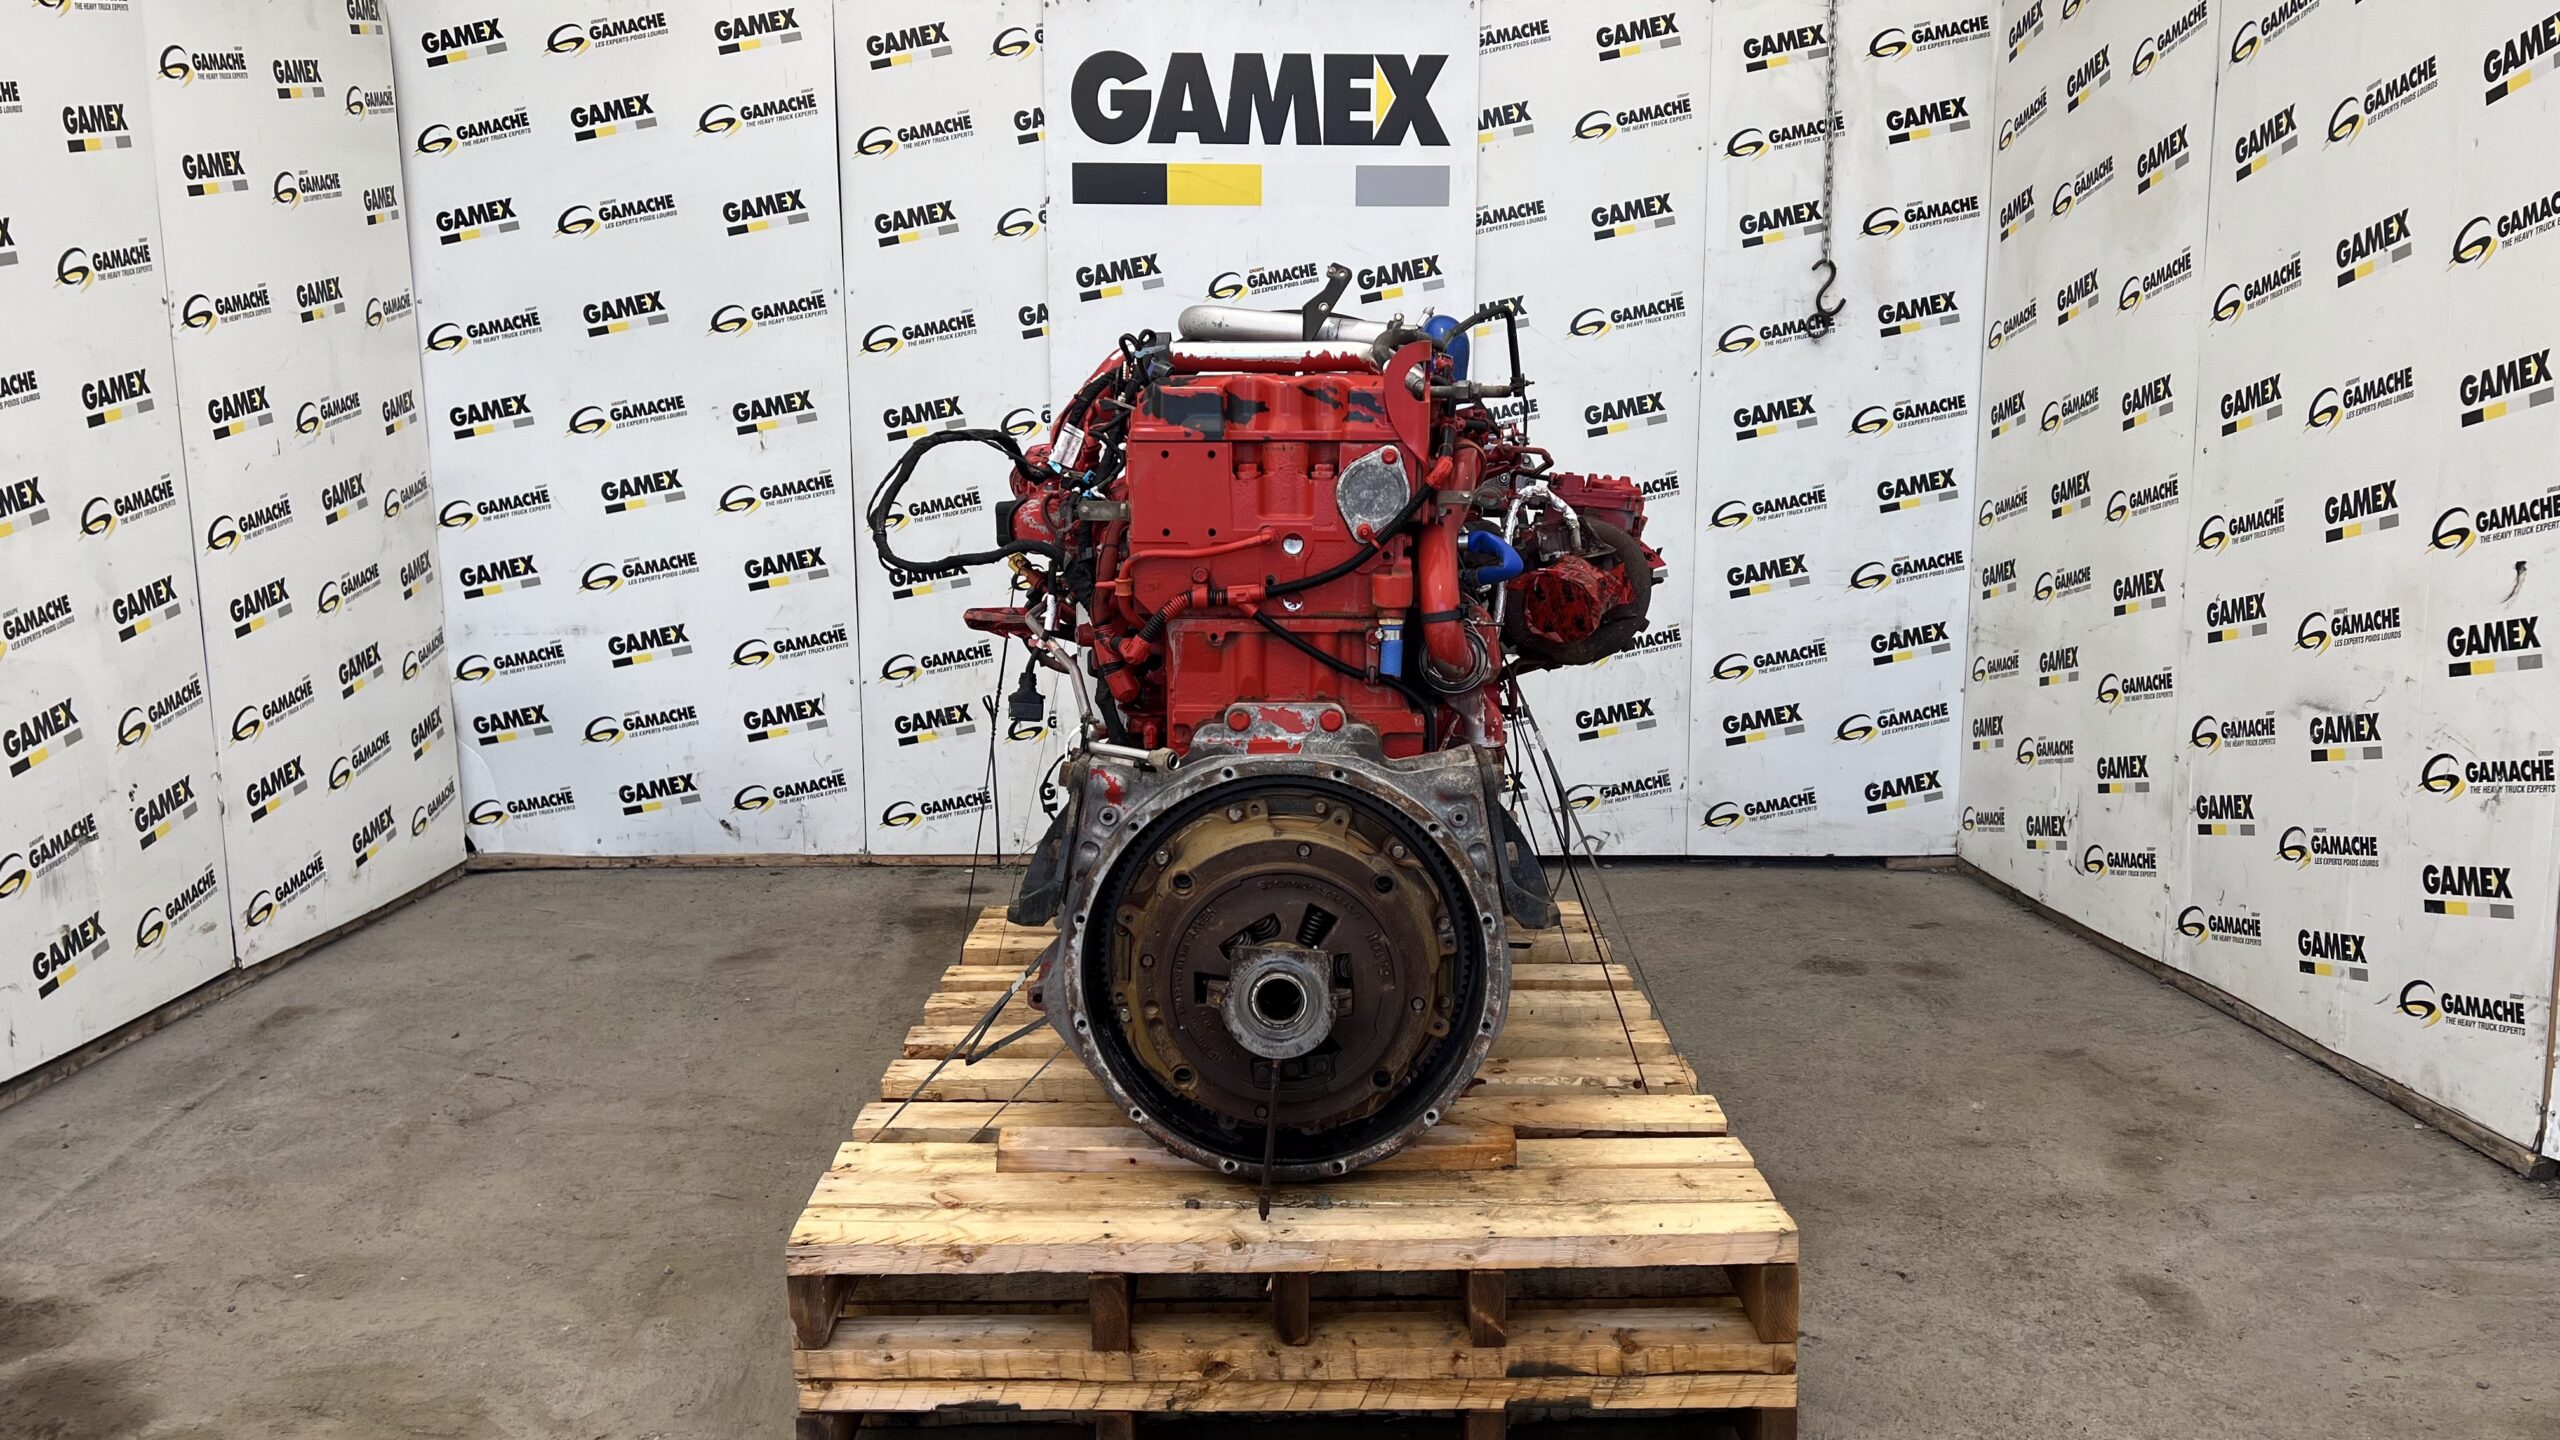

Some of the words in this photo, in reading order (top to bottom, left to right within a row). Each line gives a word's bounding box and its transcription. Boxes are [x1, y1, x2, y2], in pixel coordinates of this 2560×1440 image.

[422, 17, 504, 53] GAMEX
[589, 12, 667, 40] GAMACHE
[595, 41, 605, 49] LES
[606, 36, 629, 47] EXPERTS
[630, 32, 646, 42] POIDS
[648, 28, 669, 38] LOURDS
[714, 7, 800, 41] GAMEX
[867, 21, 950, 56] GAMEX
[1597, 12, 1680, 47] GAMEX
[1912, 15, 1990, 44] GAMACHE
[1917, 44, 1926, 53] LES
[1928, 39, 1951, 50] EXPERTS
[1952, 35, 1968, 45] POIDS
[1970, 31, 1991, 42] LOURDS
[192, 53, 247, 70] GAMACHE
[273, 59, 323, 83] GAMEX
[1071, 50, 1453, 147] GAMEX
[2364, 55, 2437, 114] GAMACHE
[63, 103, 129, 134] GAMEX
[571, 93, 654, 127] GAMEX
[740, 93, 817, 120] GAMACHE
[1616, 98, 1692, 126] GAMACHE
[1886, 96, 1969, 131] GAMEX
[2368, 113, 2377, 127] LES
[2378, 100, 2399, 121] EXPERTS
[2401, 90, 2416, 108] POIDS
[2417, 78, 2438, 99] LOURDS
[456, 111, 530, 140] GAMACHE
[898, 115, 973, 142] GAMACHE
[903, 142, 913, 150] THE
[914, 138, 931, 148] HEAVY
[932, 134, 950, 144] TRUCK
[951, 130, 974, 141] EXPERTS
[2235, 103, 2297, 163] GAMEX
[182, 150, 246, 180] GAMEX
[2137, 123, 2189, 178] GAMEX
[436, 197, 517, 231] GAMEX
[599, 194, 676, 221] GAMACHE
[723, 188, 807, 222] GAMEX
[875, 199, 957, 233] GAMEX
[1592, 192, 1674, 227] GAMEX
[1904, 195, 1979, 223] GAMACHE
[2336, 207, 2411, 268] GAMEX
[2502, 237, 2513, 250] THE
[2514, 228, 2534, 245] HEAVY
[2536, 218, 2556, 236] TRUCK
[93, 244, 152, 271] GAMACHE
[1076, 253, 1162, 288] GAMEX
[1357, 254, 1443, 290] GAMEX
[1247, 262, 1318, 288] GAMACHE
[215, 289, 270, 315] GAMACHE
[583, 290, 666, 324] GAMEX
[751, 294, 827, 320] GAMACHE
[1611, 296, 1685, 323] GAMACHE
[1878, 290, 1959, 324] GAMEX
[467, 311, 541, 338] GAMACHE
[902, 313, 976, 340] GAMACHE
[82, 368, 151, 410] GAMEX
[2343, 366, 2413, 408] GAMACHE
[2460, 348, 2553, 406] GAMEX
[208, 385, 271, 423] GAMEX
[450, 393, 532, 426] GAMEX
[610, 395, 686, 421] GAMACHE
[733, 389, 815, 422] GAMEX
[1585, 391, 1666, 424] GAMEX
[1893, 394, 1967, 421] GAMACHE
[2122, 373, 2173, 415] GAMEX
[2221, 373, 2283, 419] GAMEX
[883, 395, 964, 428] GAMEX
[1734, 394, 1816, 427] GAMEX
[114, 479, 175, 516] GAMACHE
[322, 472, 366, 510] GAMEX
[601, 468, 683, 501] GAMEX
[760, 474, 834, 500] GAMACHE
[1877, 467, 1957, 500] GAMEX
[2130, 479, 2179, 509] GAMACHE
[239, 499, 292, 532] GAMACHE
[477, 489, 550, 515] GAMACHE
[909, 490, 982, 516] GAMACHE
[1752, 489, 1827, 515] GAMACHE
[2325, 479, 2399, 524] GAMEX
[2229, 504, 2285, 536] GAMACHE
[2480, 534, 2491, 545] THE
[2492, 529, 2513, 542] HEAVY
[2514, 525, 2534, 538] TRUCK
[460, 554, 538, 586] GAMEX
[622, 551, 698, 578] GAMACHE
[745, 546, 826, 578] GAMEX
[1727, 553, 1809, 586] GAMEX
[1891, 550, 1964, 577] GAMACHE
[113, 574, 178, 624] GAMEX
[230, 577, 290, 622] GAMEX
[2114, 568, 2166, 601] GAMEX
[3, 594, 72, 640] GAMACHE
[2207, 592, 2267, 627] GAMEX
[2331, 607, 2401, 636] GAMACHE
[608, 623, 690, 655] GAMEX
[774, 627, 848, 653] GAMACHE
[1871, 621, 1950, 653] GAMEX
[2447, 615, 2542, 657] GAMEX
[494, 644, 565, 669] GAMACHE
[921, 643, 993, 668] GAMACHE
[1754, 642, 1827, 668] GAMACHE
[2040, 645, 2079, 673] GAMEX
[3, 697, 79, 758] GAMEX
[473, 704, 550, 734] GAMEX
[623, 705, 697, 731] GAMACHE
[744, 697, 826, 730] GAMEX
[895, 703, 974, 734] GAMEX
[1576, 697, 1655, 729] GAMEX
[1723, 702, 1804, 734] GAMEX
[1877, 702, 1949, 728] GAMACHE
[2221, 717, 2276, 739] GAMACHE
[2310, 712, 2382, 744] GAMEX
[247, 755, 305, 806] GAMEX
[2097, 754, 2149, 779] GAMEX
[2465, 759, 2555, 783] GAMACHE
[619, 772, 698, 803] GAMEX
[773, 772, 847, 799] GAMACHE
[1865, 769, 1942, 801] GAMEX
[2470, 785, 2481, 795] THE
[2505, 784, 2525, 794] TRUCK
[2527, 784, 2556, 794] EXPERTS
[135, 774, 195, 832] GAMEX
[1744, 791, 1817, 816] GAMACHE
[2196, 794, 2254, 820] GAMEX
[29, 813, 97, 869] GAMACHE
[2311, 835, 2378, 856] GAMACHE
[166, 868, 217, 920] GAMACHE
[275, 855, 325, 902] GAMACHE
[2423, 864, 2513, 899] GAMEX
[2209, 914, 2262, 937] GAMACHE
[33, 910, 106, 980] GAMEX
[2298, 929, 2368, 963] GAMEX
[2441, 992, 2526, 1024] GAMACHE
[2446, 1016, 2456, 1026] THE
[2458, 1017, 2476, 1029] HEAVY
[2478, 1020, 2497, 1032] TRUCK
[2499, 1024, 2526, 1037] EXPERTS
